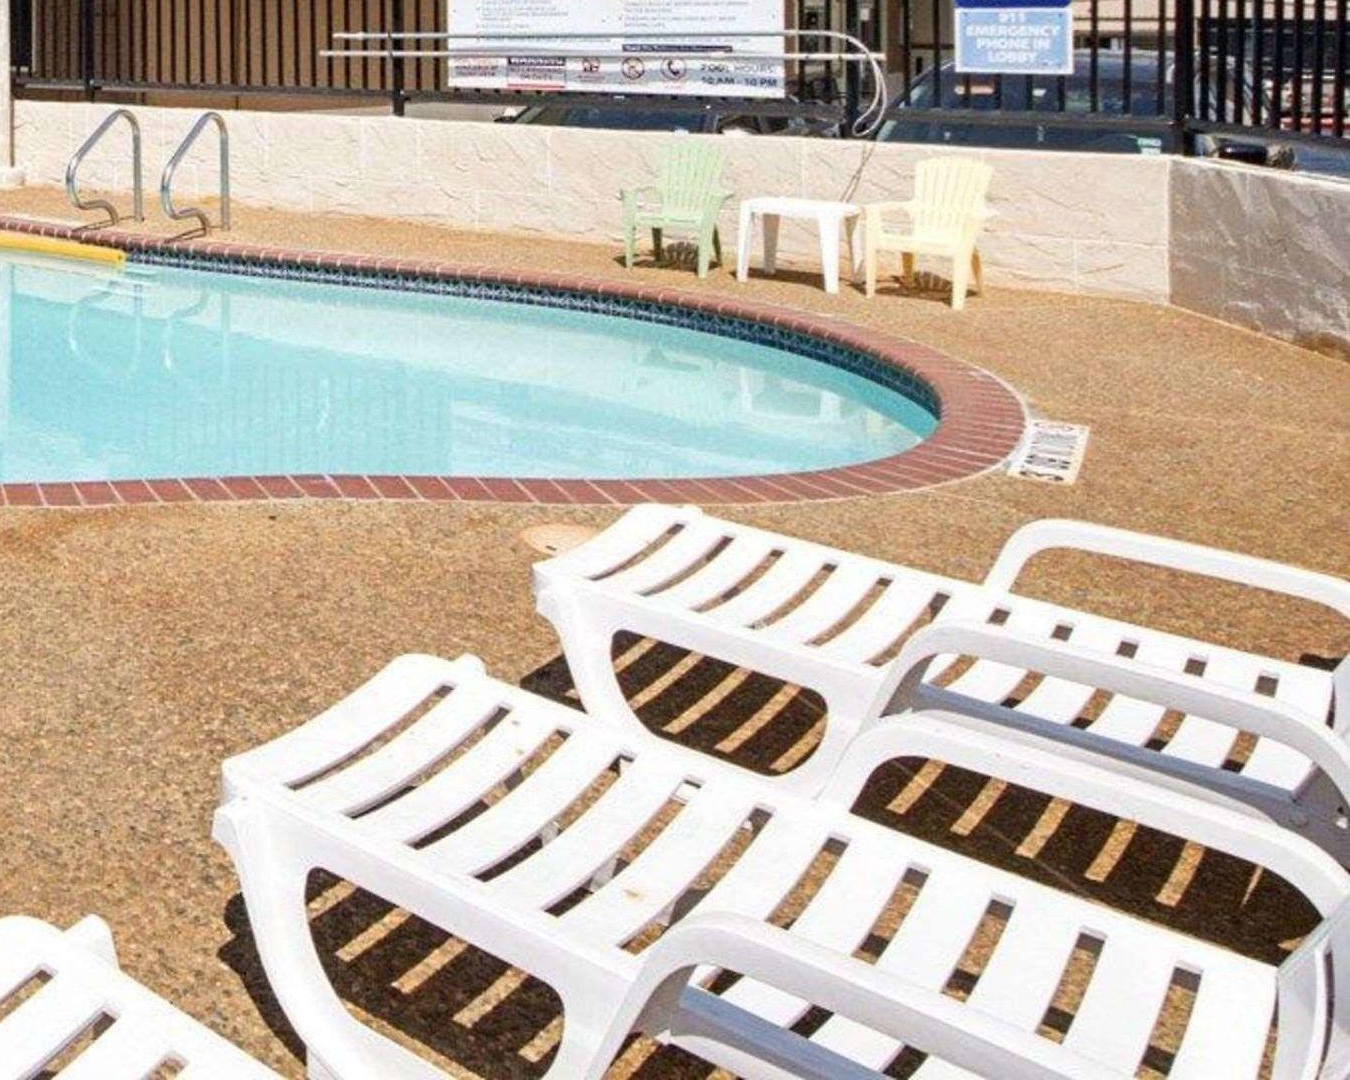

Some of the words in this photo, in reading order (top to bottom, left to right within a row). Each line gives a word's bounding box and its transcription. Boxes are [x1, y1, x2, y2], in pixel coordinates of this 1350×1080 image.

[965, 25, 1061, 37] EMERGENCY
[976, 37, 1030, 50] PHONE
[1033, 38, 1051, 50] IN
[988, 51, 1038, 63] LOBBY
[716, 76, 735, 85] AM
[744, 77, 758, 87] 10
[760, 77, 778, 87] PM
